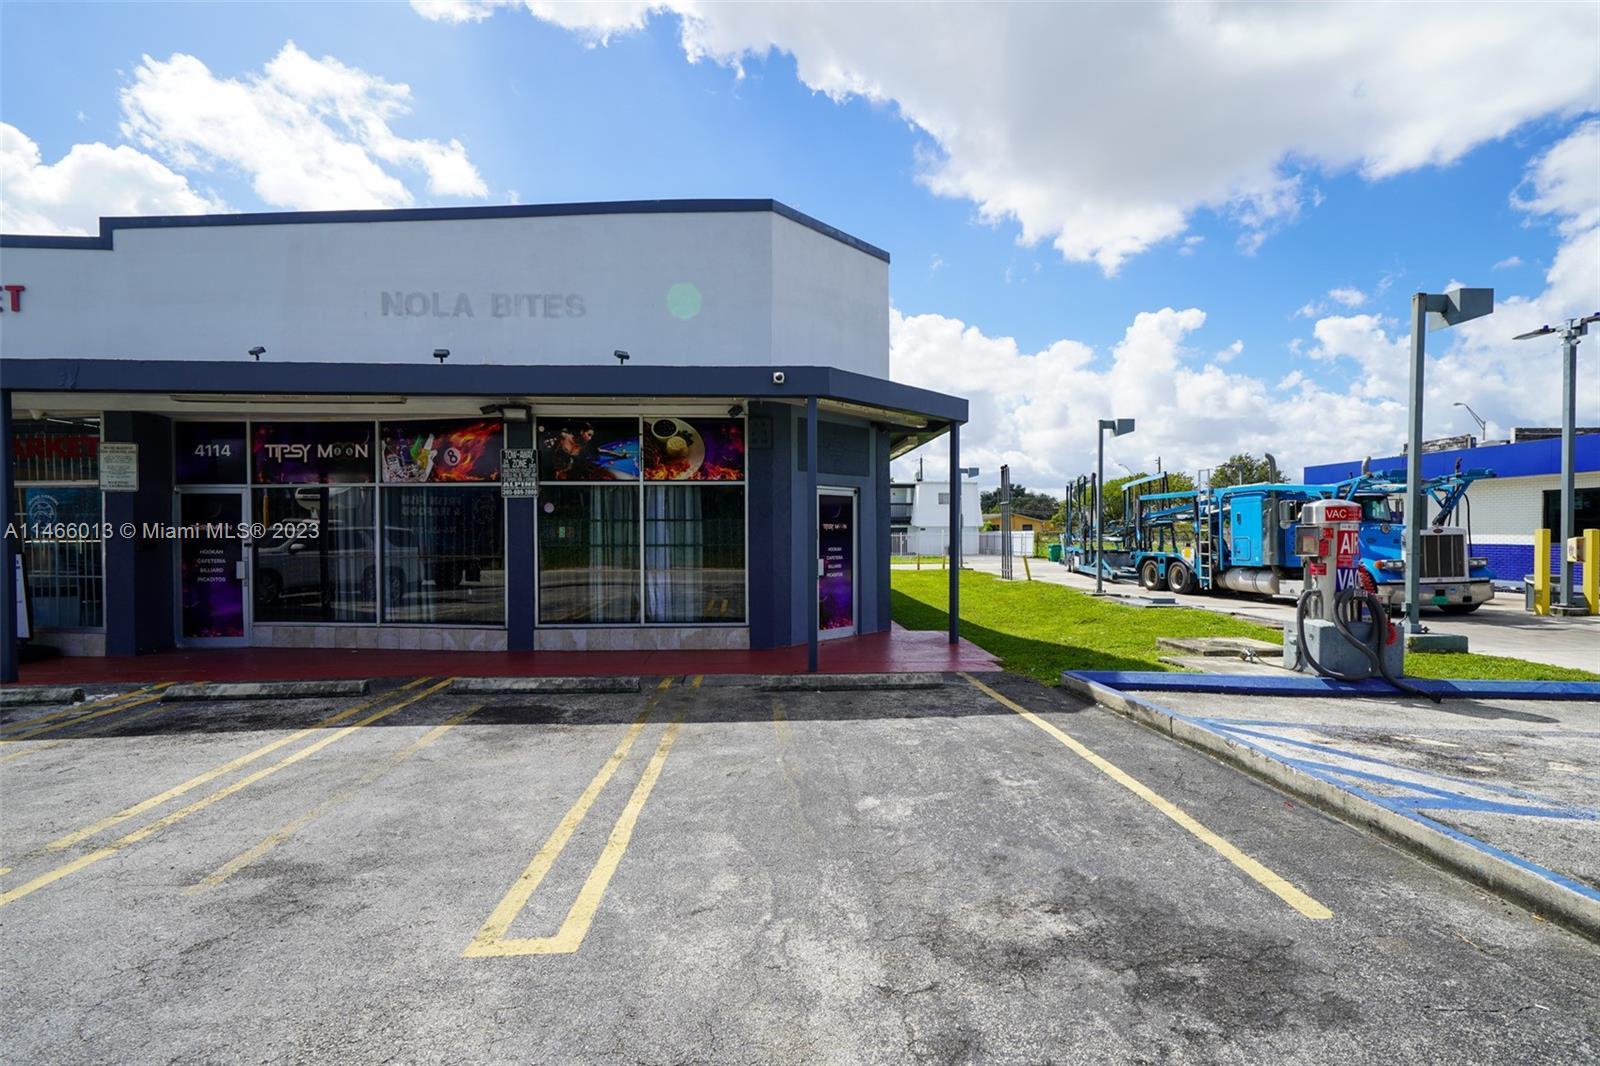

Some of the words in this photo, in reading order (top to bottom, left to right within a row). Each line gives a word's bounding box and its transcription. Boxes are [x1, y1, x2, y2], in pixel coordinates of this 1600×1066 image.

[0, 284, 26, 312] T
[380, 291, 475, 318] NOLA
[490, 292, 588, 319] BITES
[12, 434, 99, 460] ARKET
[194, 444, 232, 457] 4114
[264, 444, 311, 463] TIPSY
[447, 450, 458, 463] 8
[1326, 509, 1347, 519] VAC
